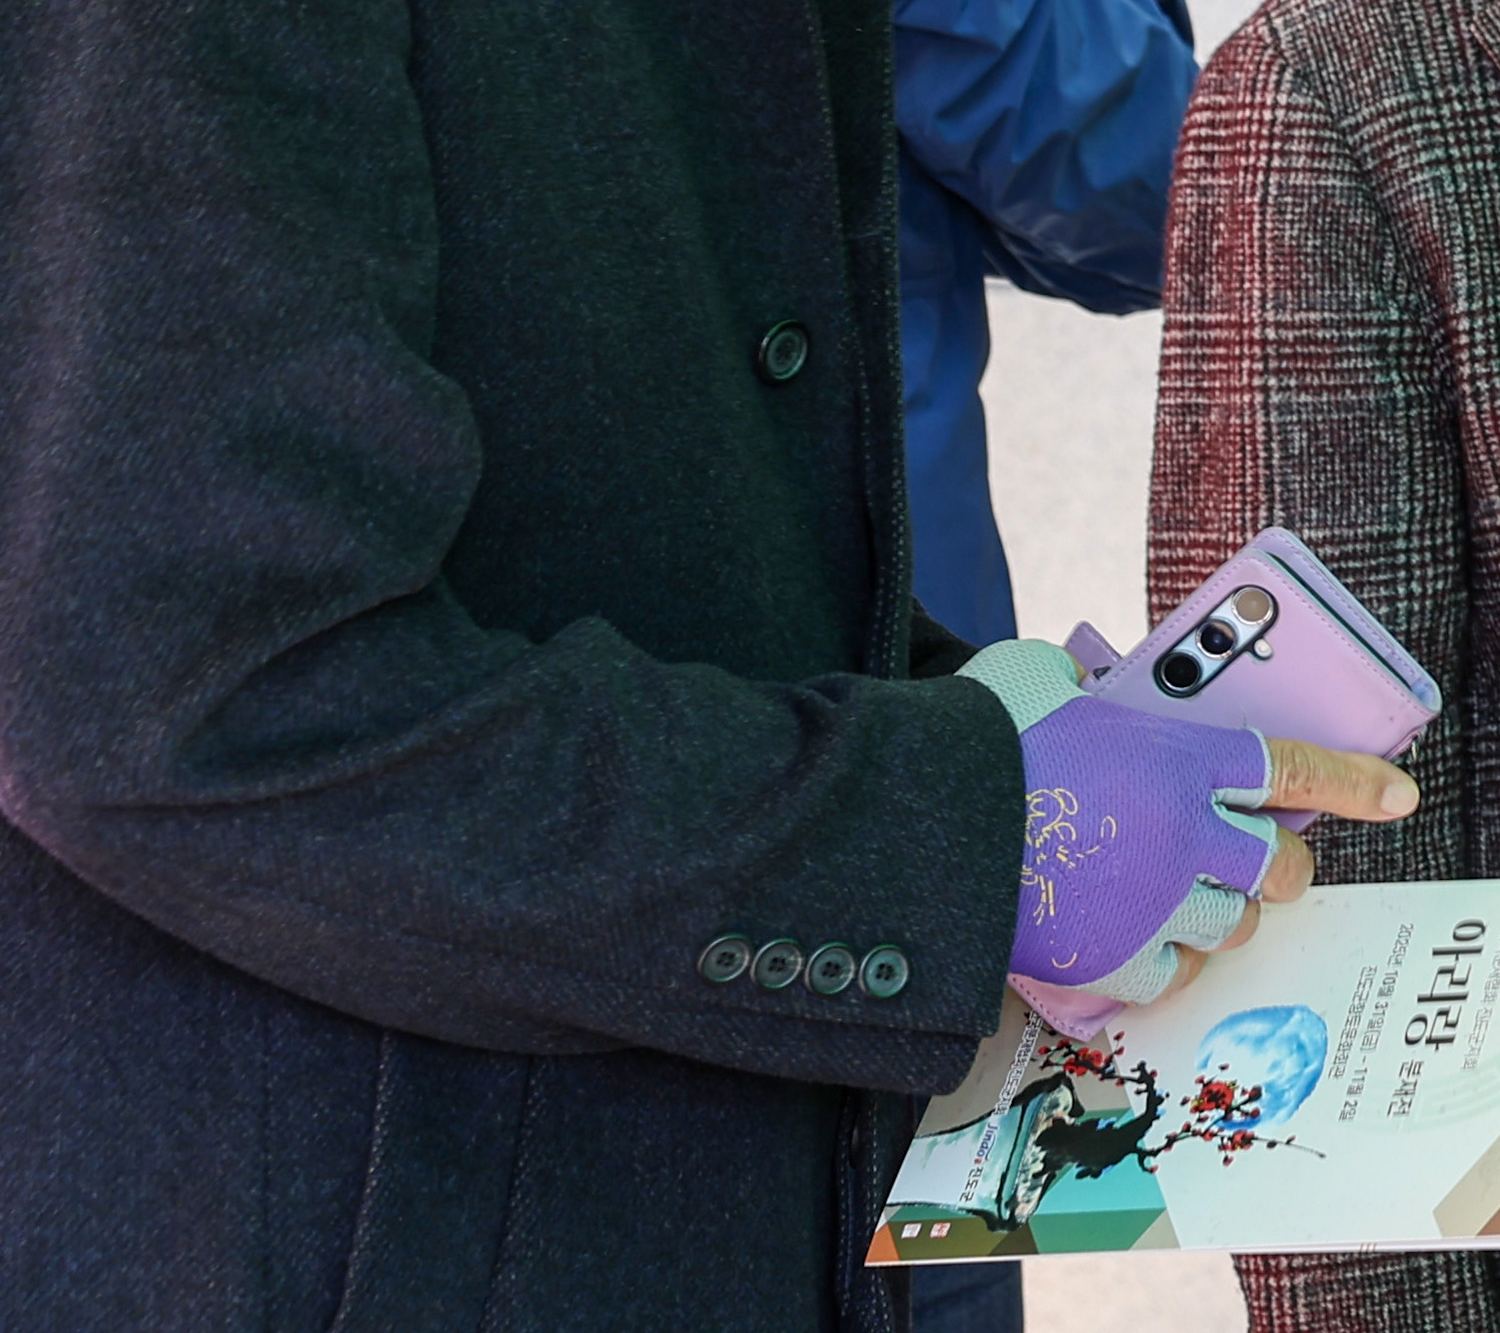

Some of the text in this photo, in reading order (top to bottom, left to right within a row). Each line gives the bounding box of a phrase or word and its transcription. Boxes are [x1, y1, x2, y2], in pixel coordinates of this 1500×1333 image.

[1387, 923, 1415, 967] 2025년
[1376, 970, 1399, 998] 10월
[1360, 1001, 1389, 1052] 31일(금)
[1387, 919, 1487, 1117] 아리랑 분재전
[1462, 1007, 1493, 1071] 진도군지회
[1346, 1067, 1368, 1096] 11월
[1338, 1100, 1358, 1122] 2일
[976, 1122, 998, 1159] Jindo
[959, 1166, 984, 1203] 진도군
